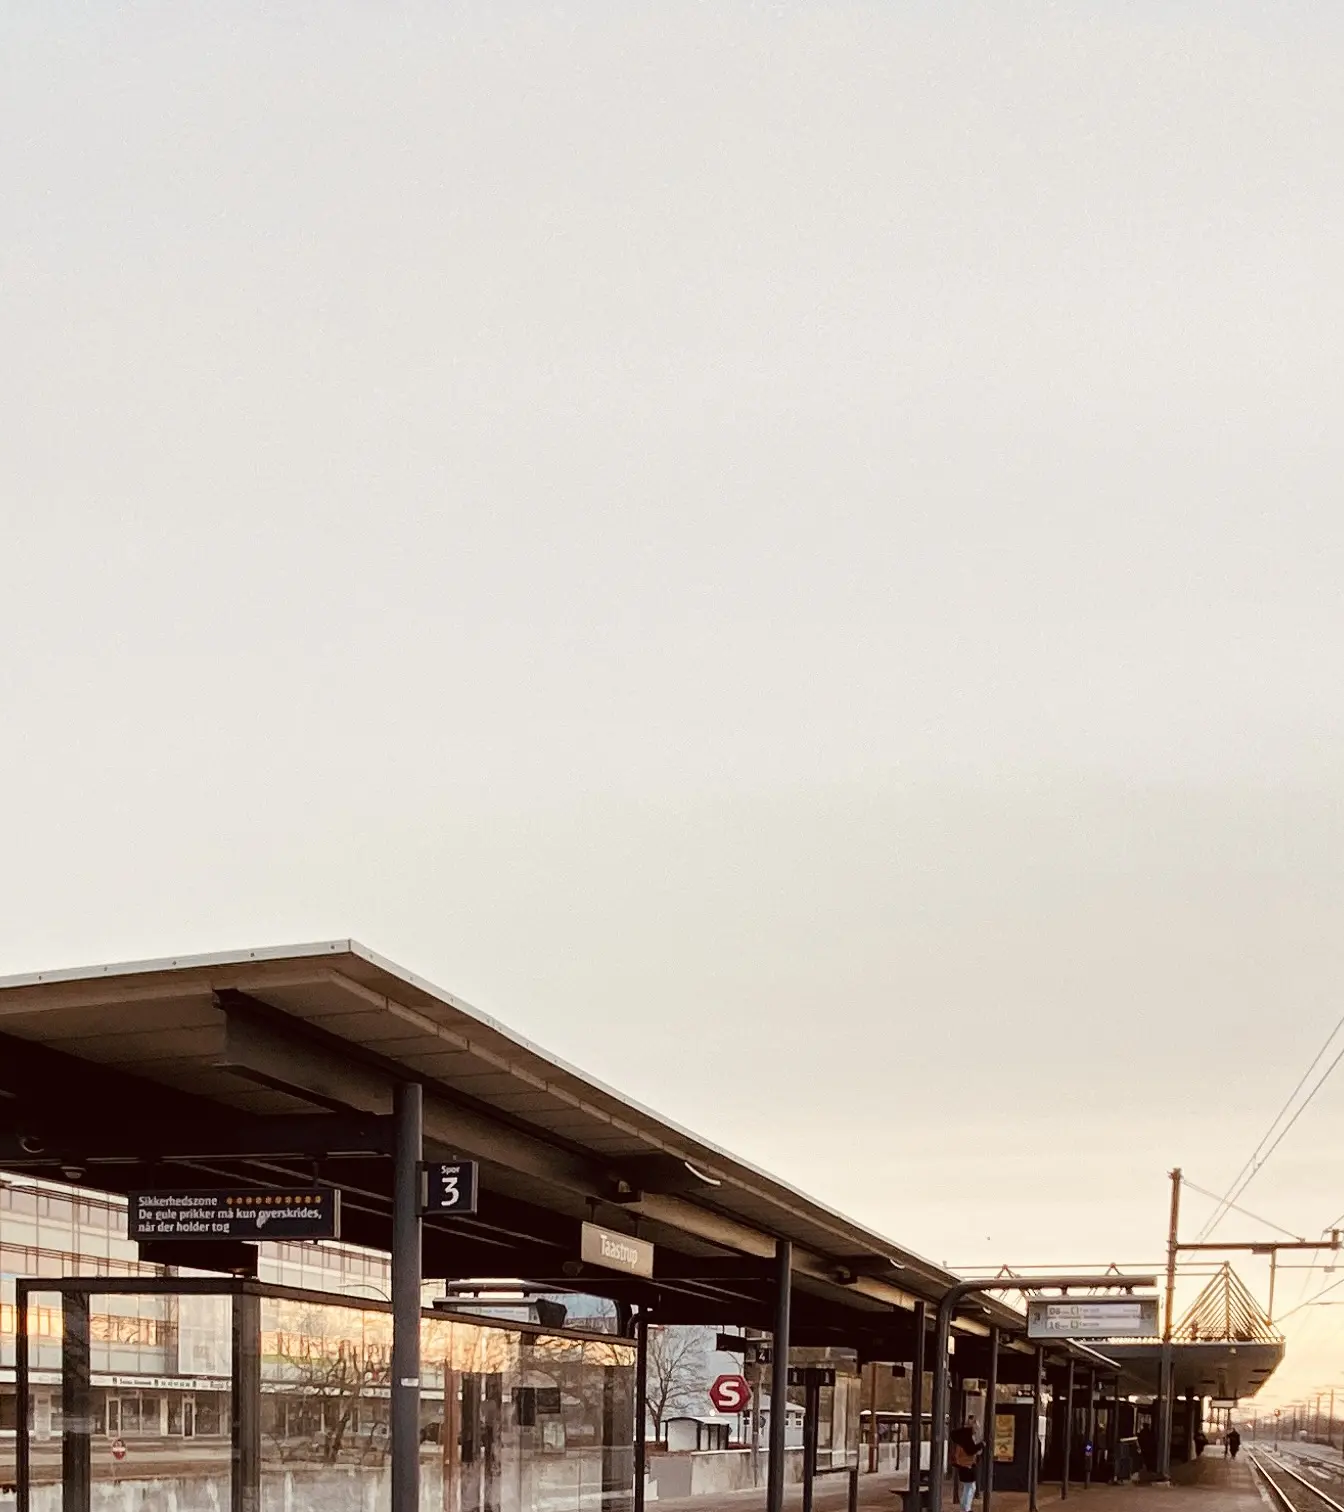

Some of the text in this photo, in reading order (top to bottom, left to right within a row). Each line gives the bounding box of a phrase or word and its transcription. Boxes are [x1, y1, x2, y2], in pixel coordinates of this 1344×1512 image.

[441, 1165, 460, 1175] Spor
[441, 1177, 460, 1207] 3
[138, 1195, 218, 1207] Sikkerhedszone
[138, 1207, 322, 1221] De gule prikker må kun overskrides,
[138, 1221, 230, 1233] når der holder tog
[600, 1234, 638, 1269] Taastrup
[718, 1381, 741, 1407] S
